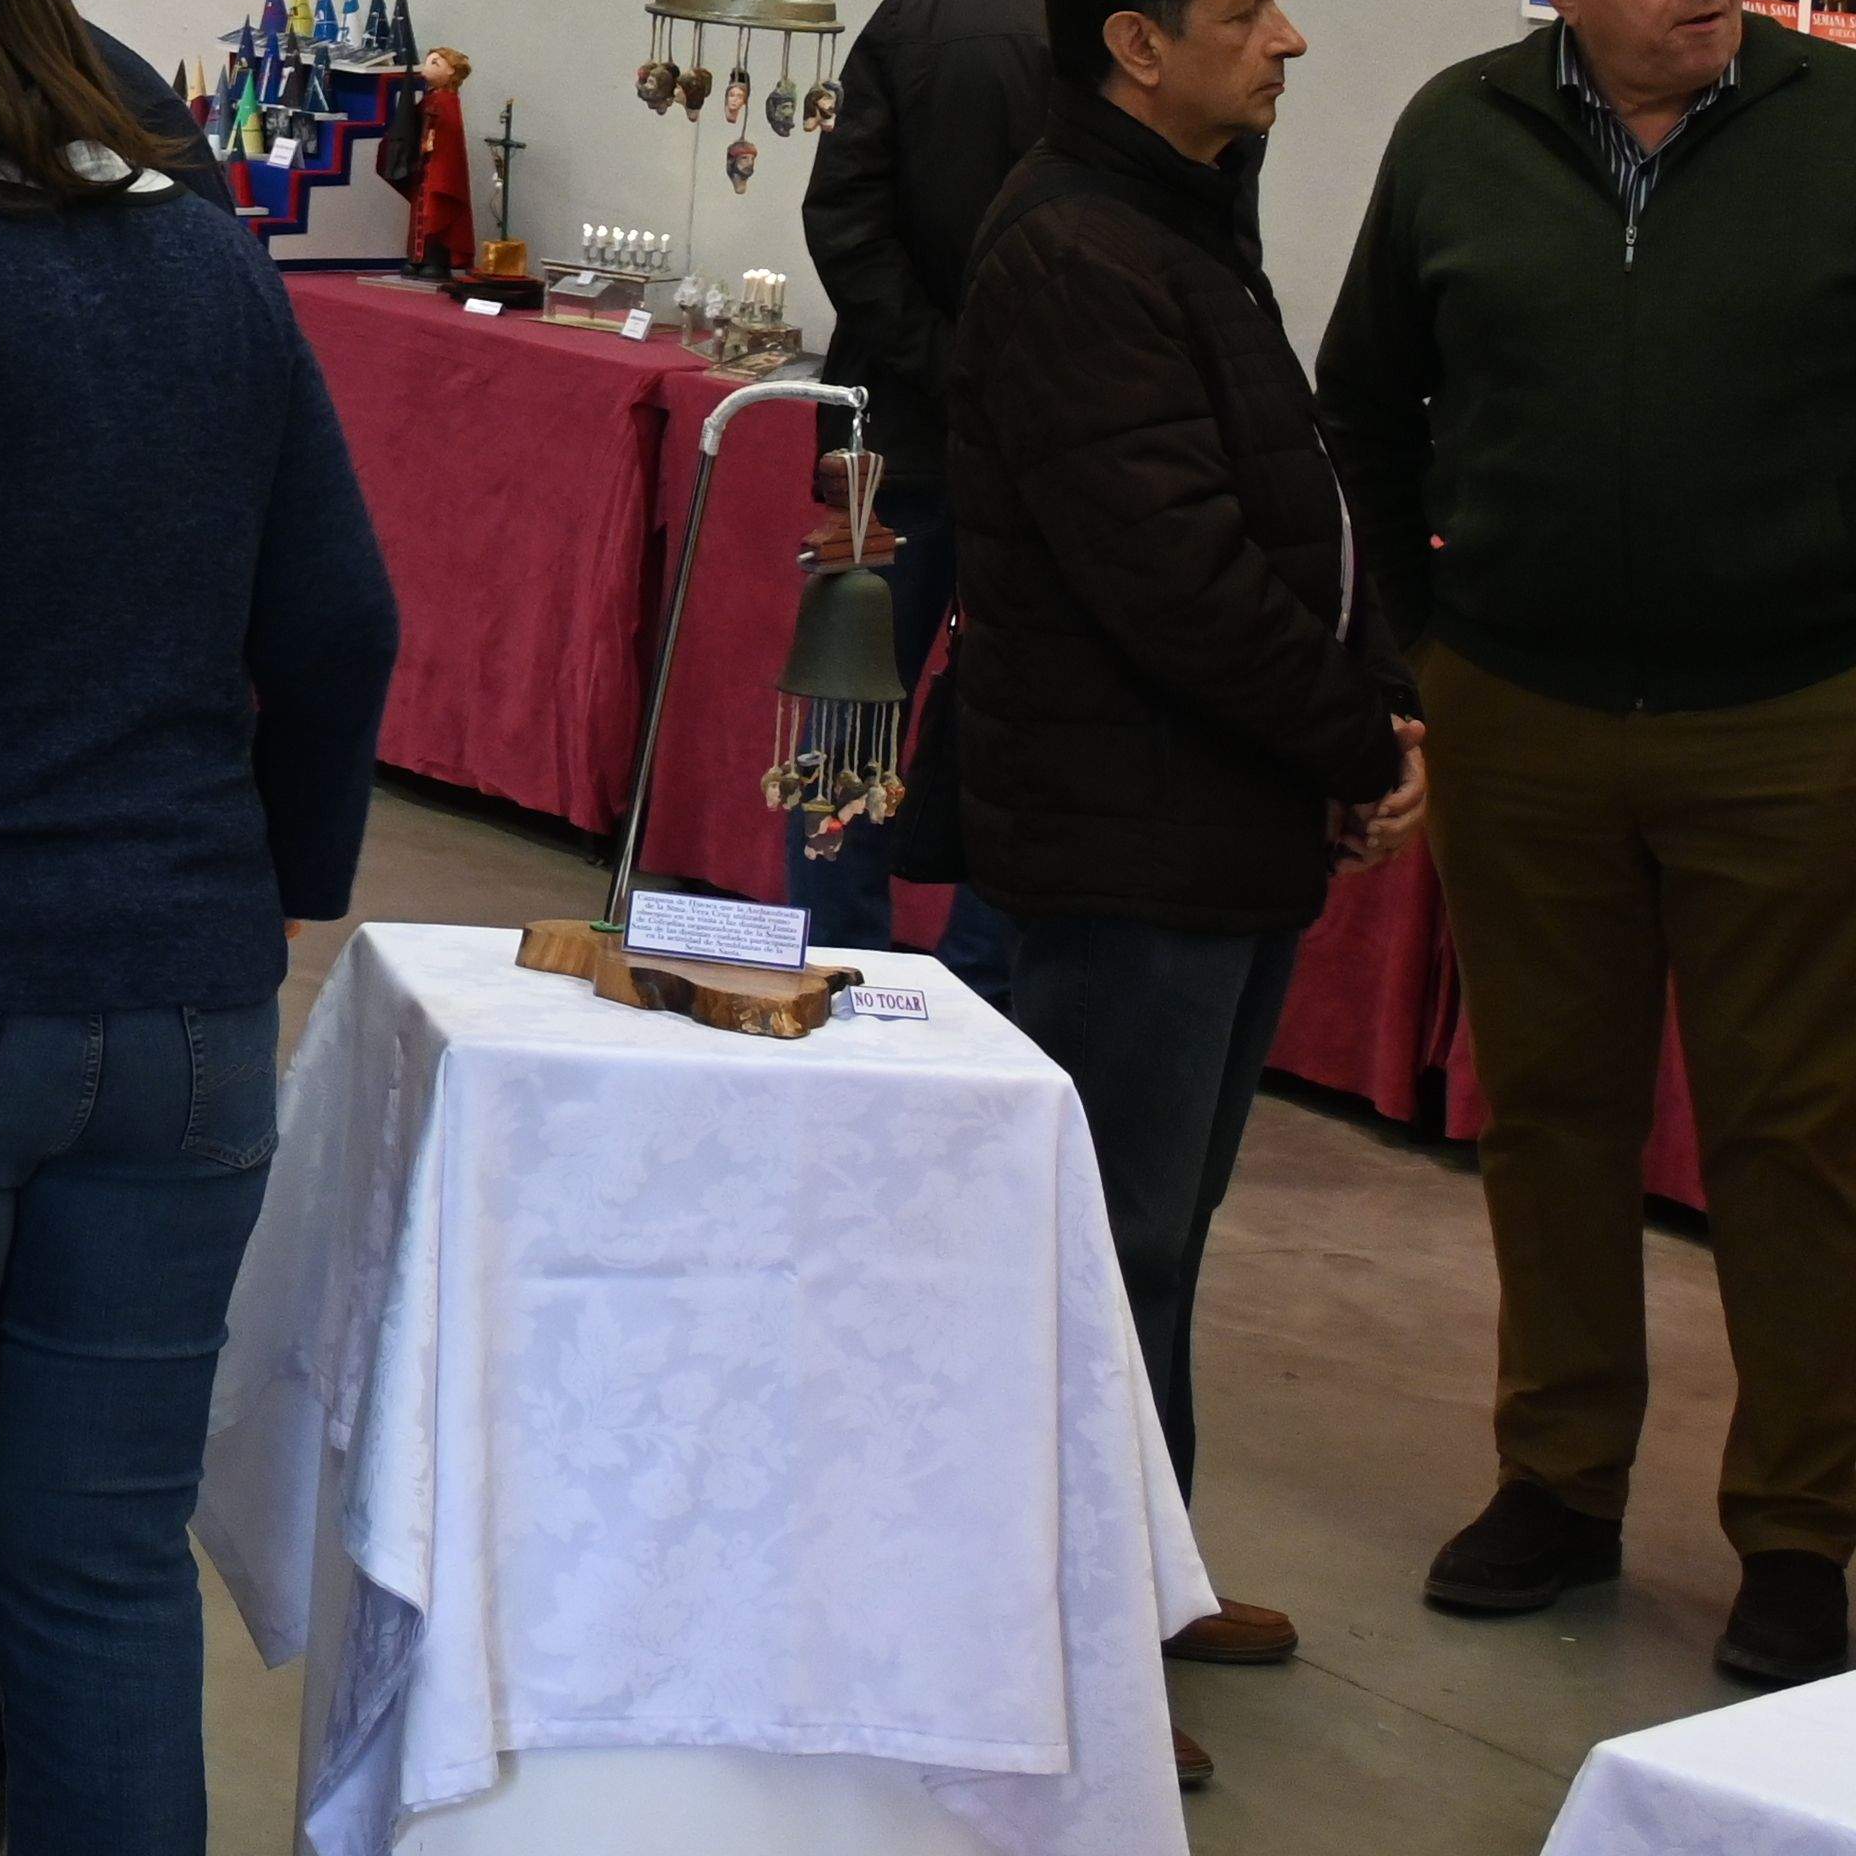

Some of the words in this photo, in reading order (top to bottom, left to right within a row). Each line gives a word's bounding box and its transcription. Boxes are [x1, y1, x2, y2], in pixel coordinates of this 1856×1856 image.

[1742, 1, 1767, 15] MANA
[1769, 3, 1797, 17] SANTA
[1812, 12, 1846, 27] SEMANA
[854, 992, 874, 1008] NO
[876, 993, 922, 1011] TOCAR
